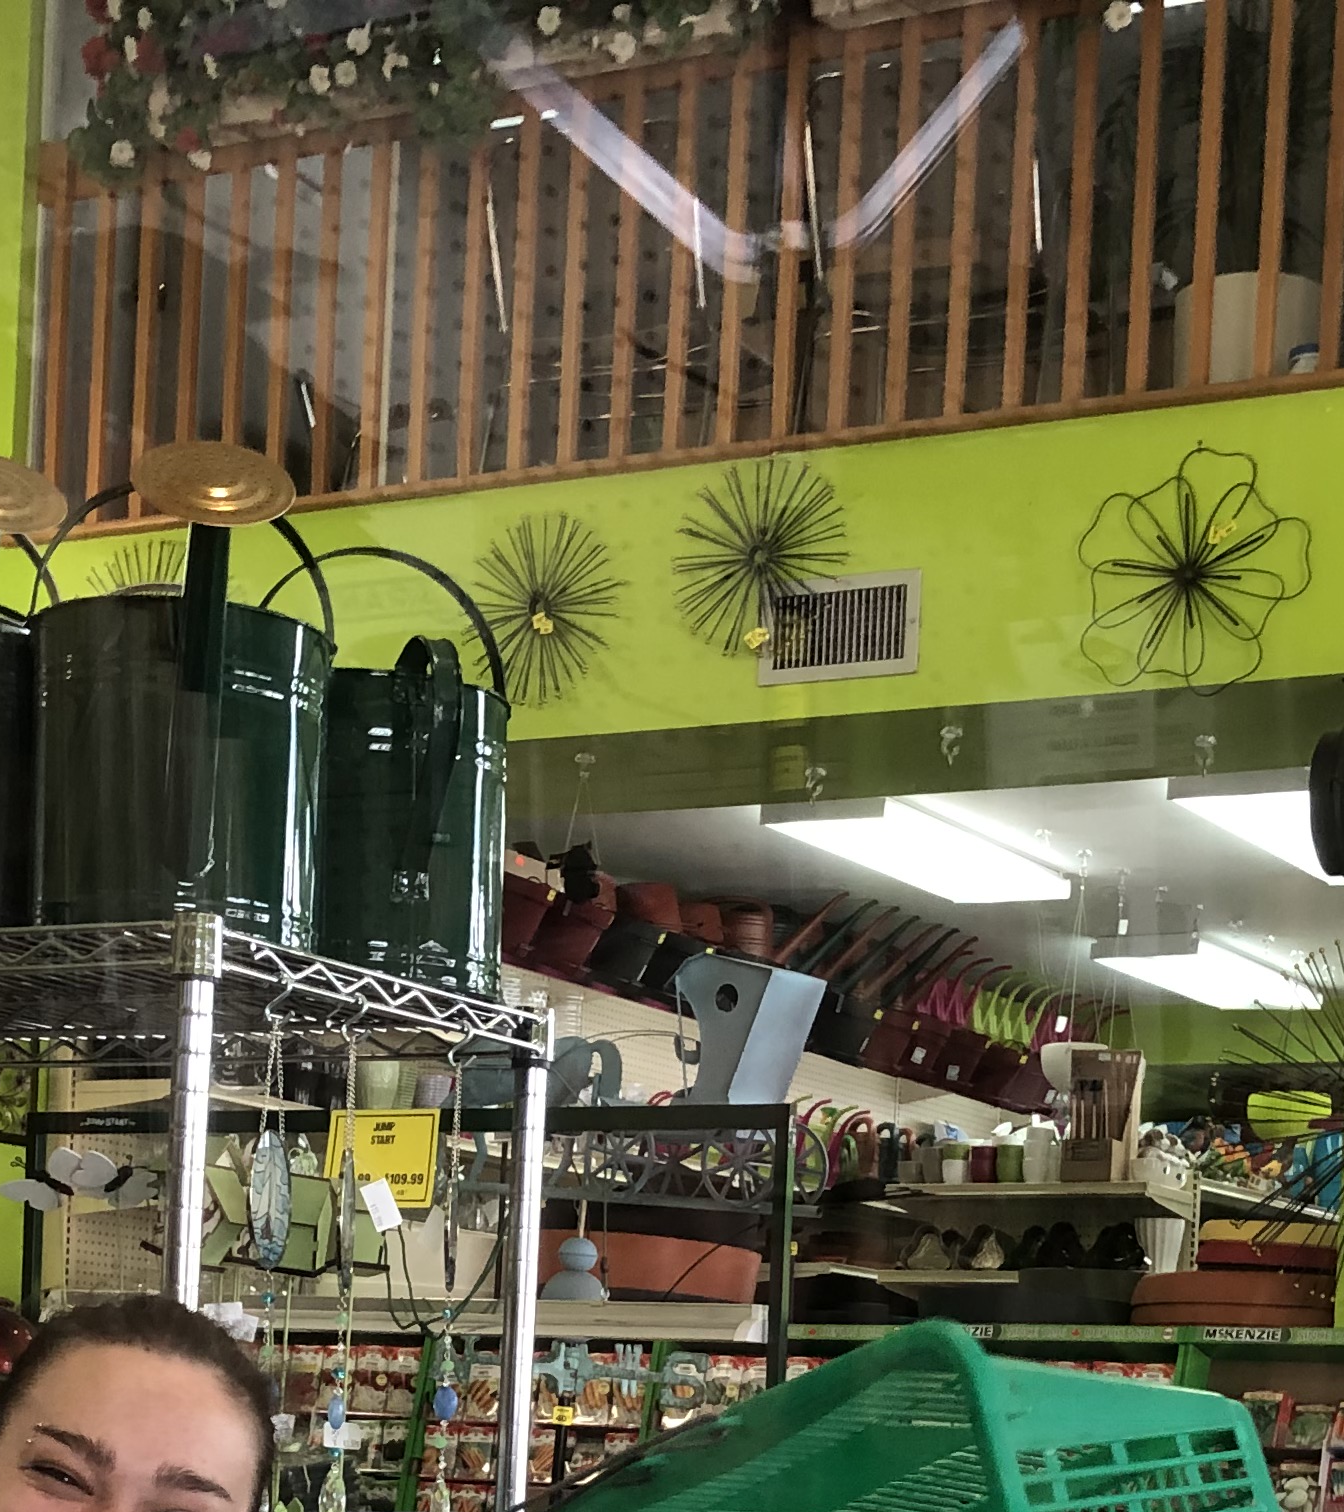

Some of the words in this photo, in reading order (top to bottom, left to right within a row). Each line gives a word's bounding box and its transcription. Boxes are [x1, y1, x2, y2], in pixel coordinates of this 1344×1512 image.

[372, 1121, 397, 1133] JUMP
[369, 1134, 396, 1146] START
[385, 1172, 424, 1186] $109.99
